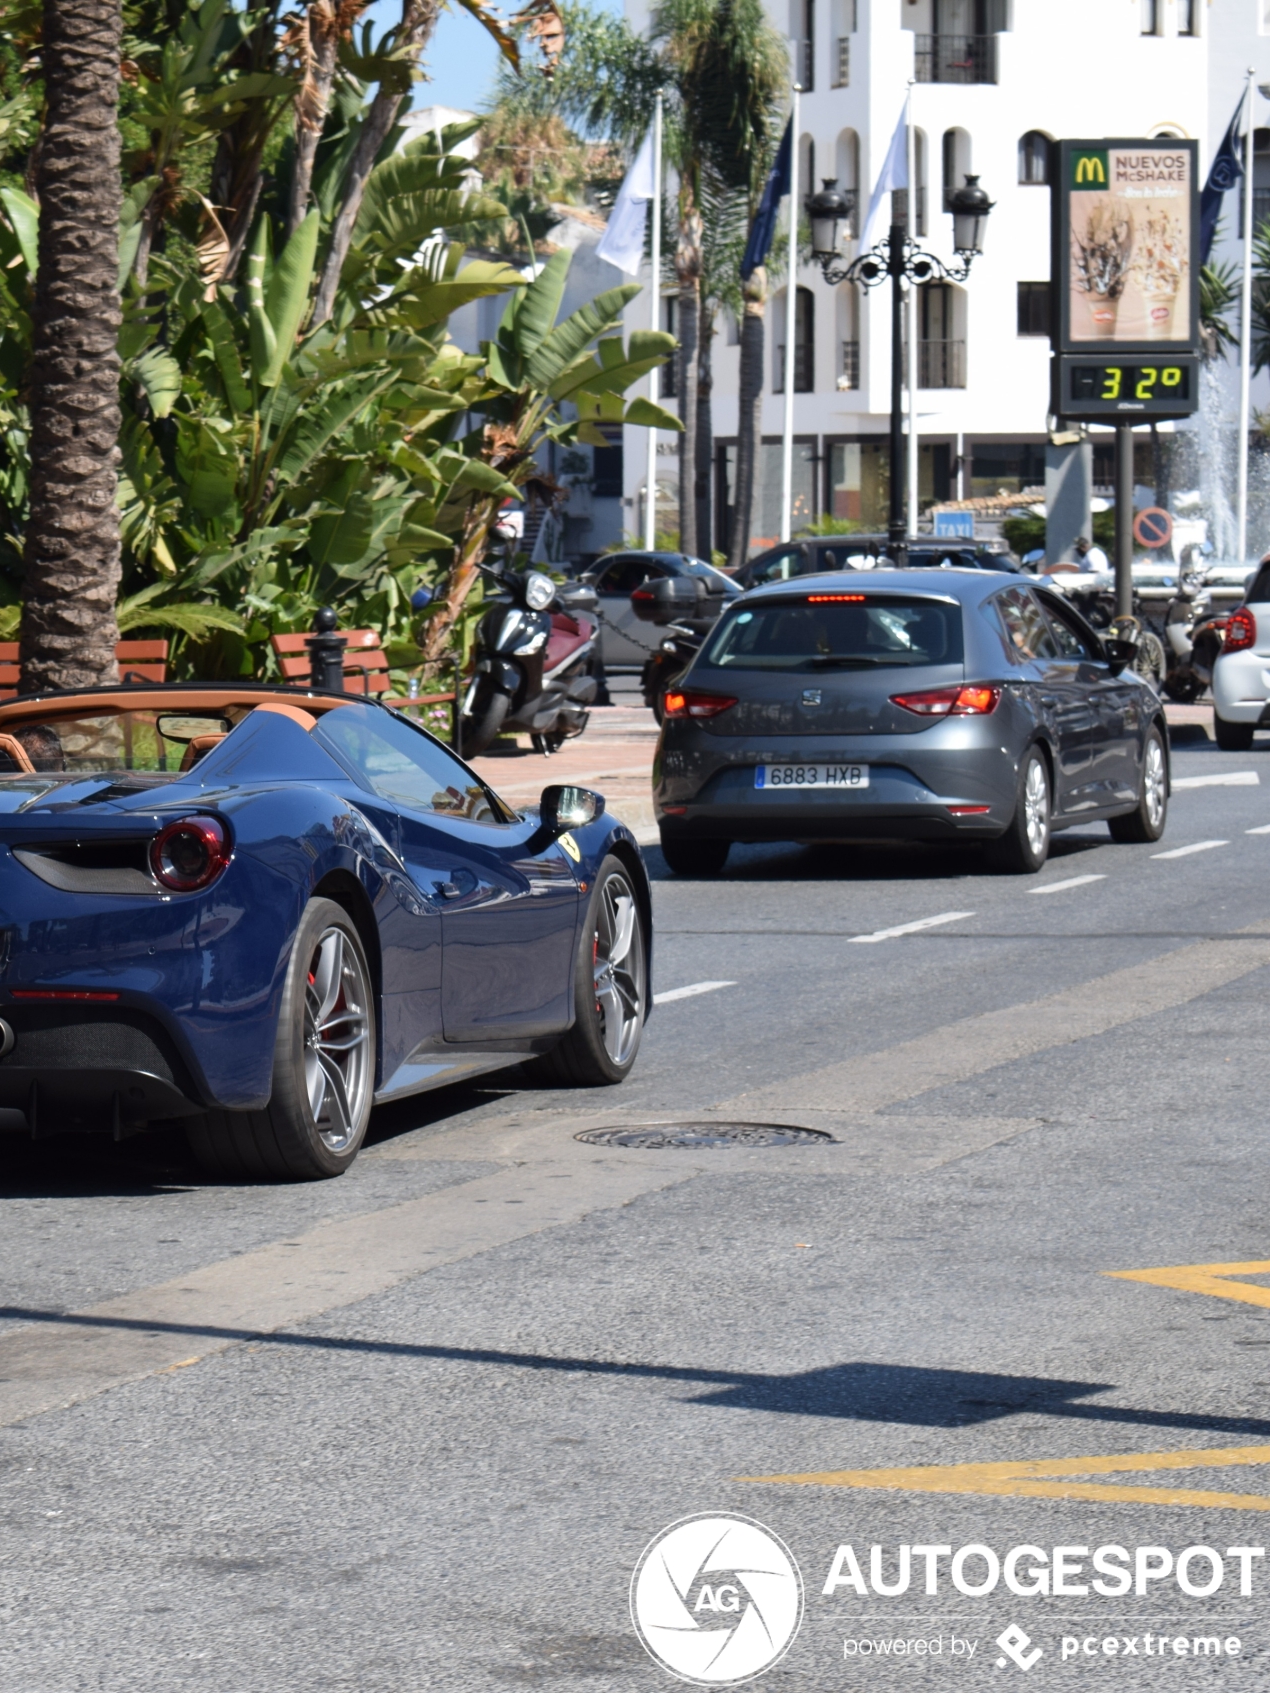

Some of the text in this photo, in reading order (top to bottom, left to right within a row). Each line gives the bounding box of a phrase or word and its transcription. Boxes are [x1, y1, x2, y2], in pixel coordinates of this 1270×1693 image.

[1116, 156, 1185, 169] NUEVOS
[1116, 170, 1185, 181] McSHAKE
[938, 523, 970, 537] TAXI
[771, 767, 862, 785] 6883 HXB
